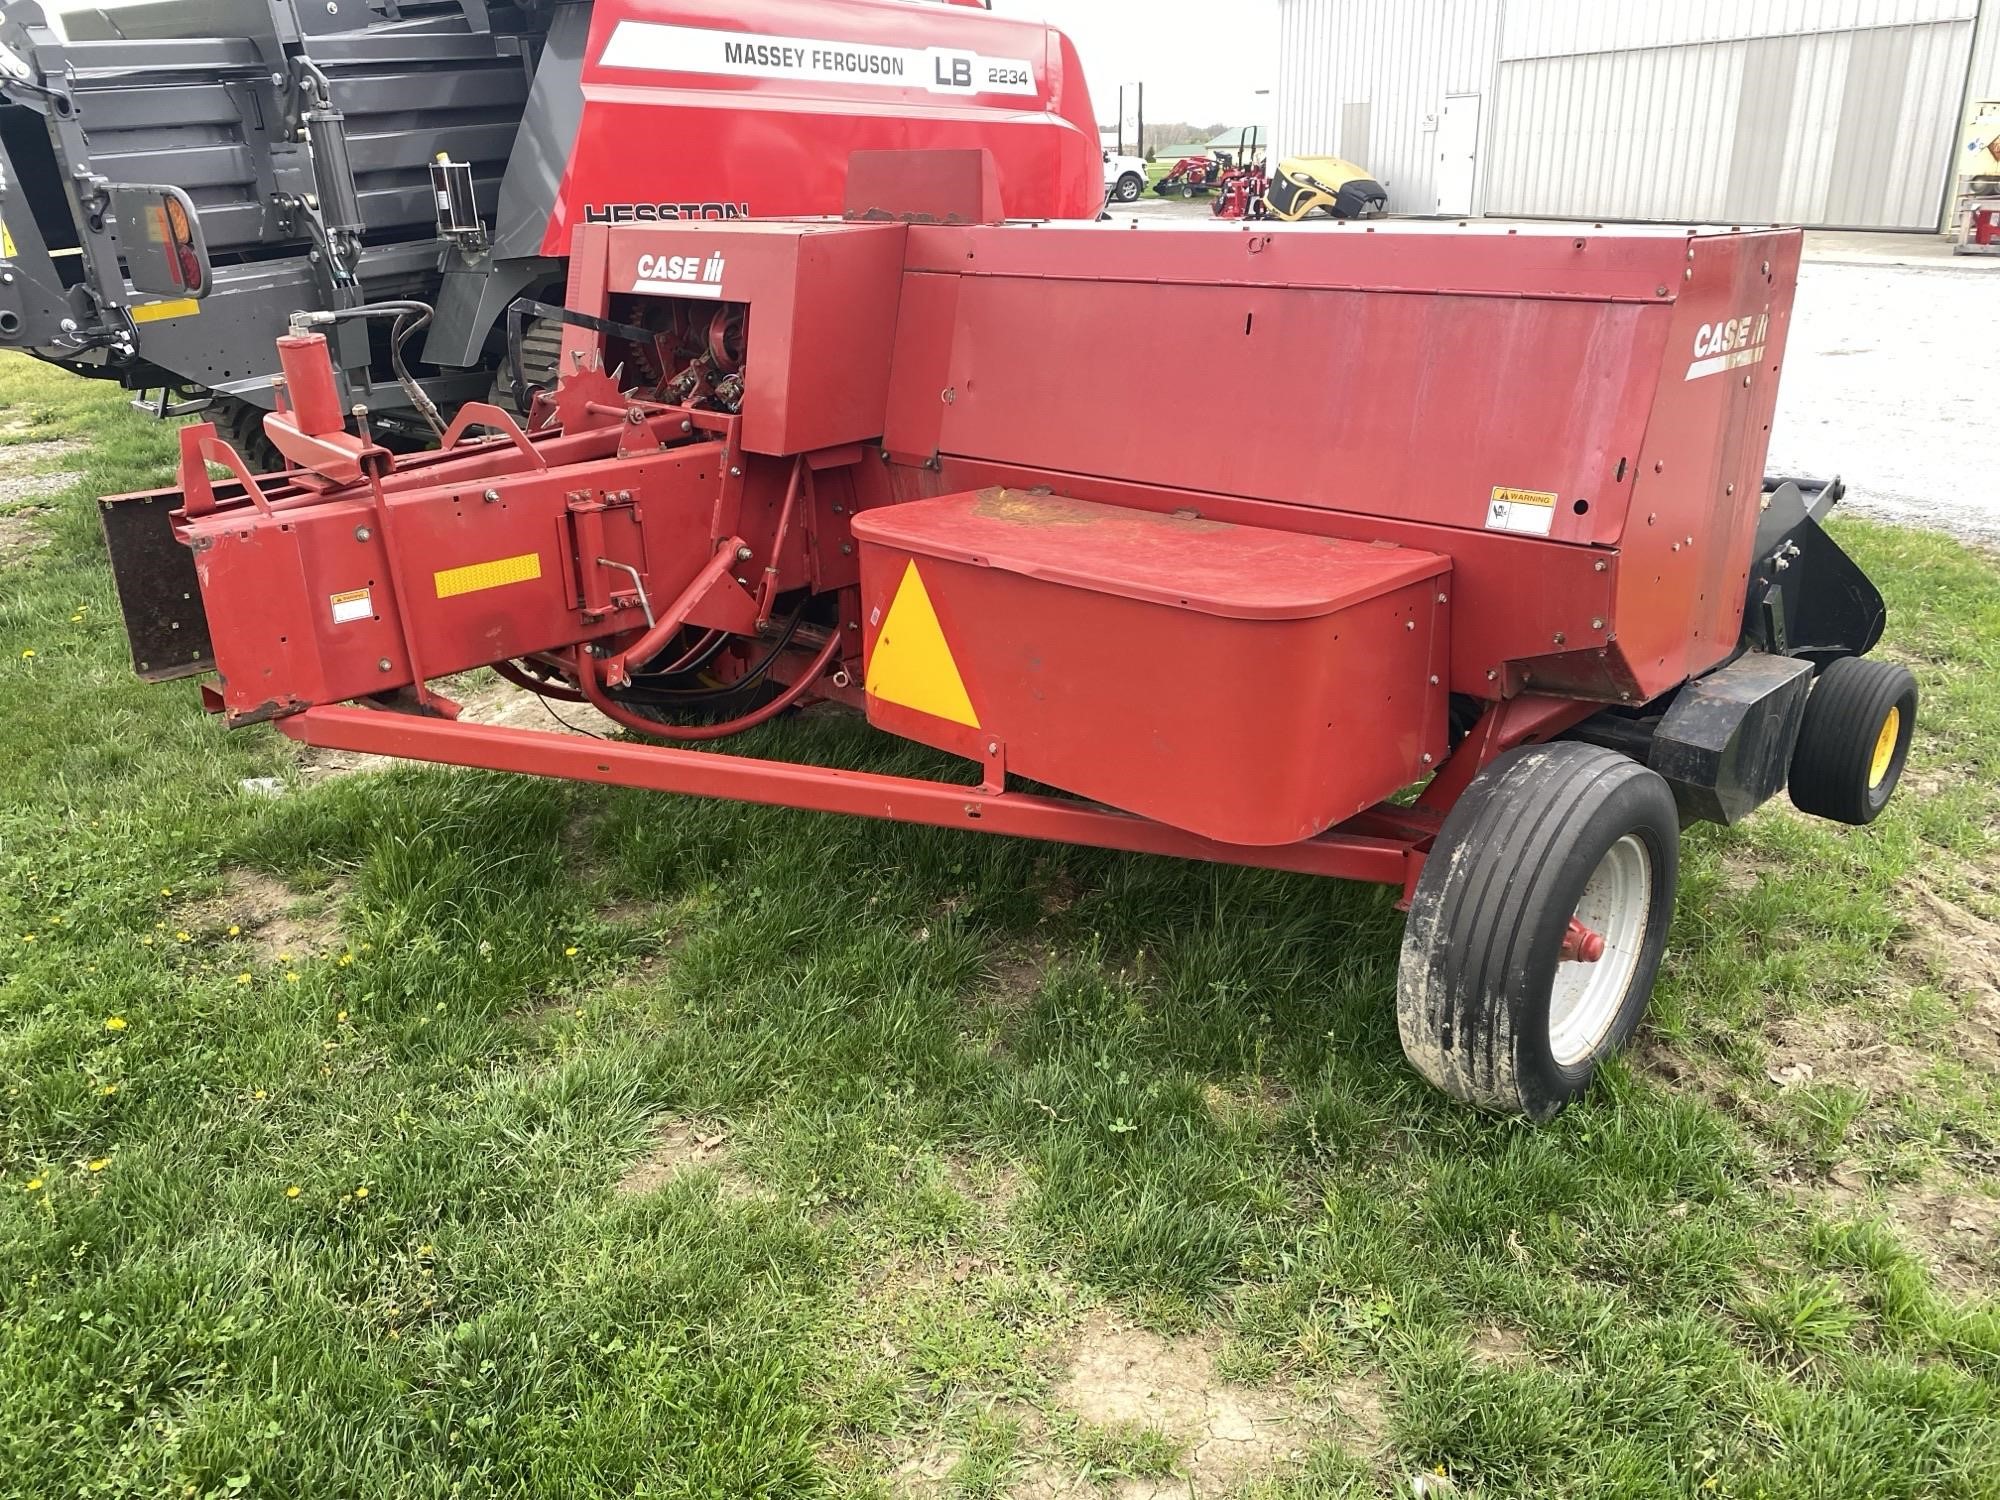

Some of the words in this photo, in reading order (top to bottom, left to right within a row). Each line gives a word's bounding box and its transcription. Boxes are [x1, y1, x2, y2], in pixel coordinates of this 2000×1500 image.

[725, 42, 805, 68] MASSEY
[812, 50, 904, 76] FERGUSON
[935, 56, 972, 87] LB
[988, 67, 1028, 86] 2234
[637, 254, 701, 281] CASE
[1693, 315, 1753, 358] CASE
[1510, 492, 1551, 504] WARNING
